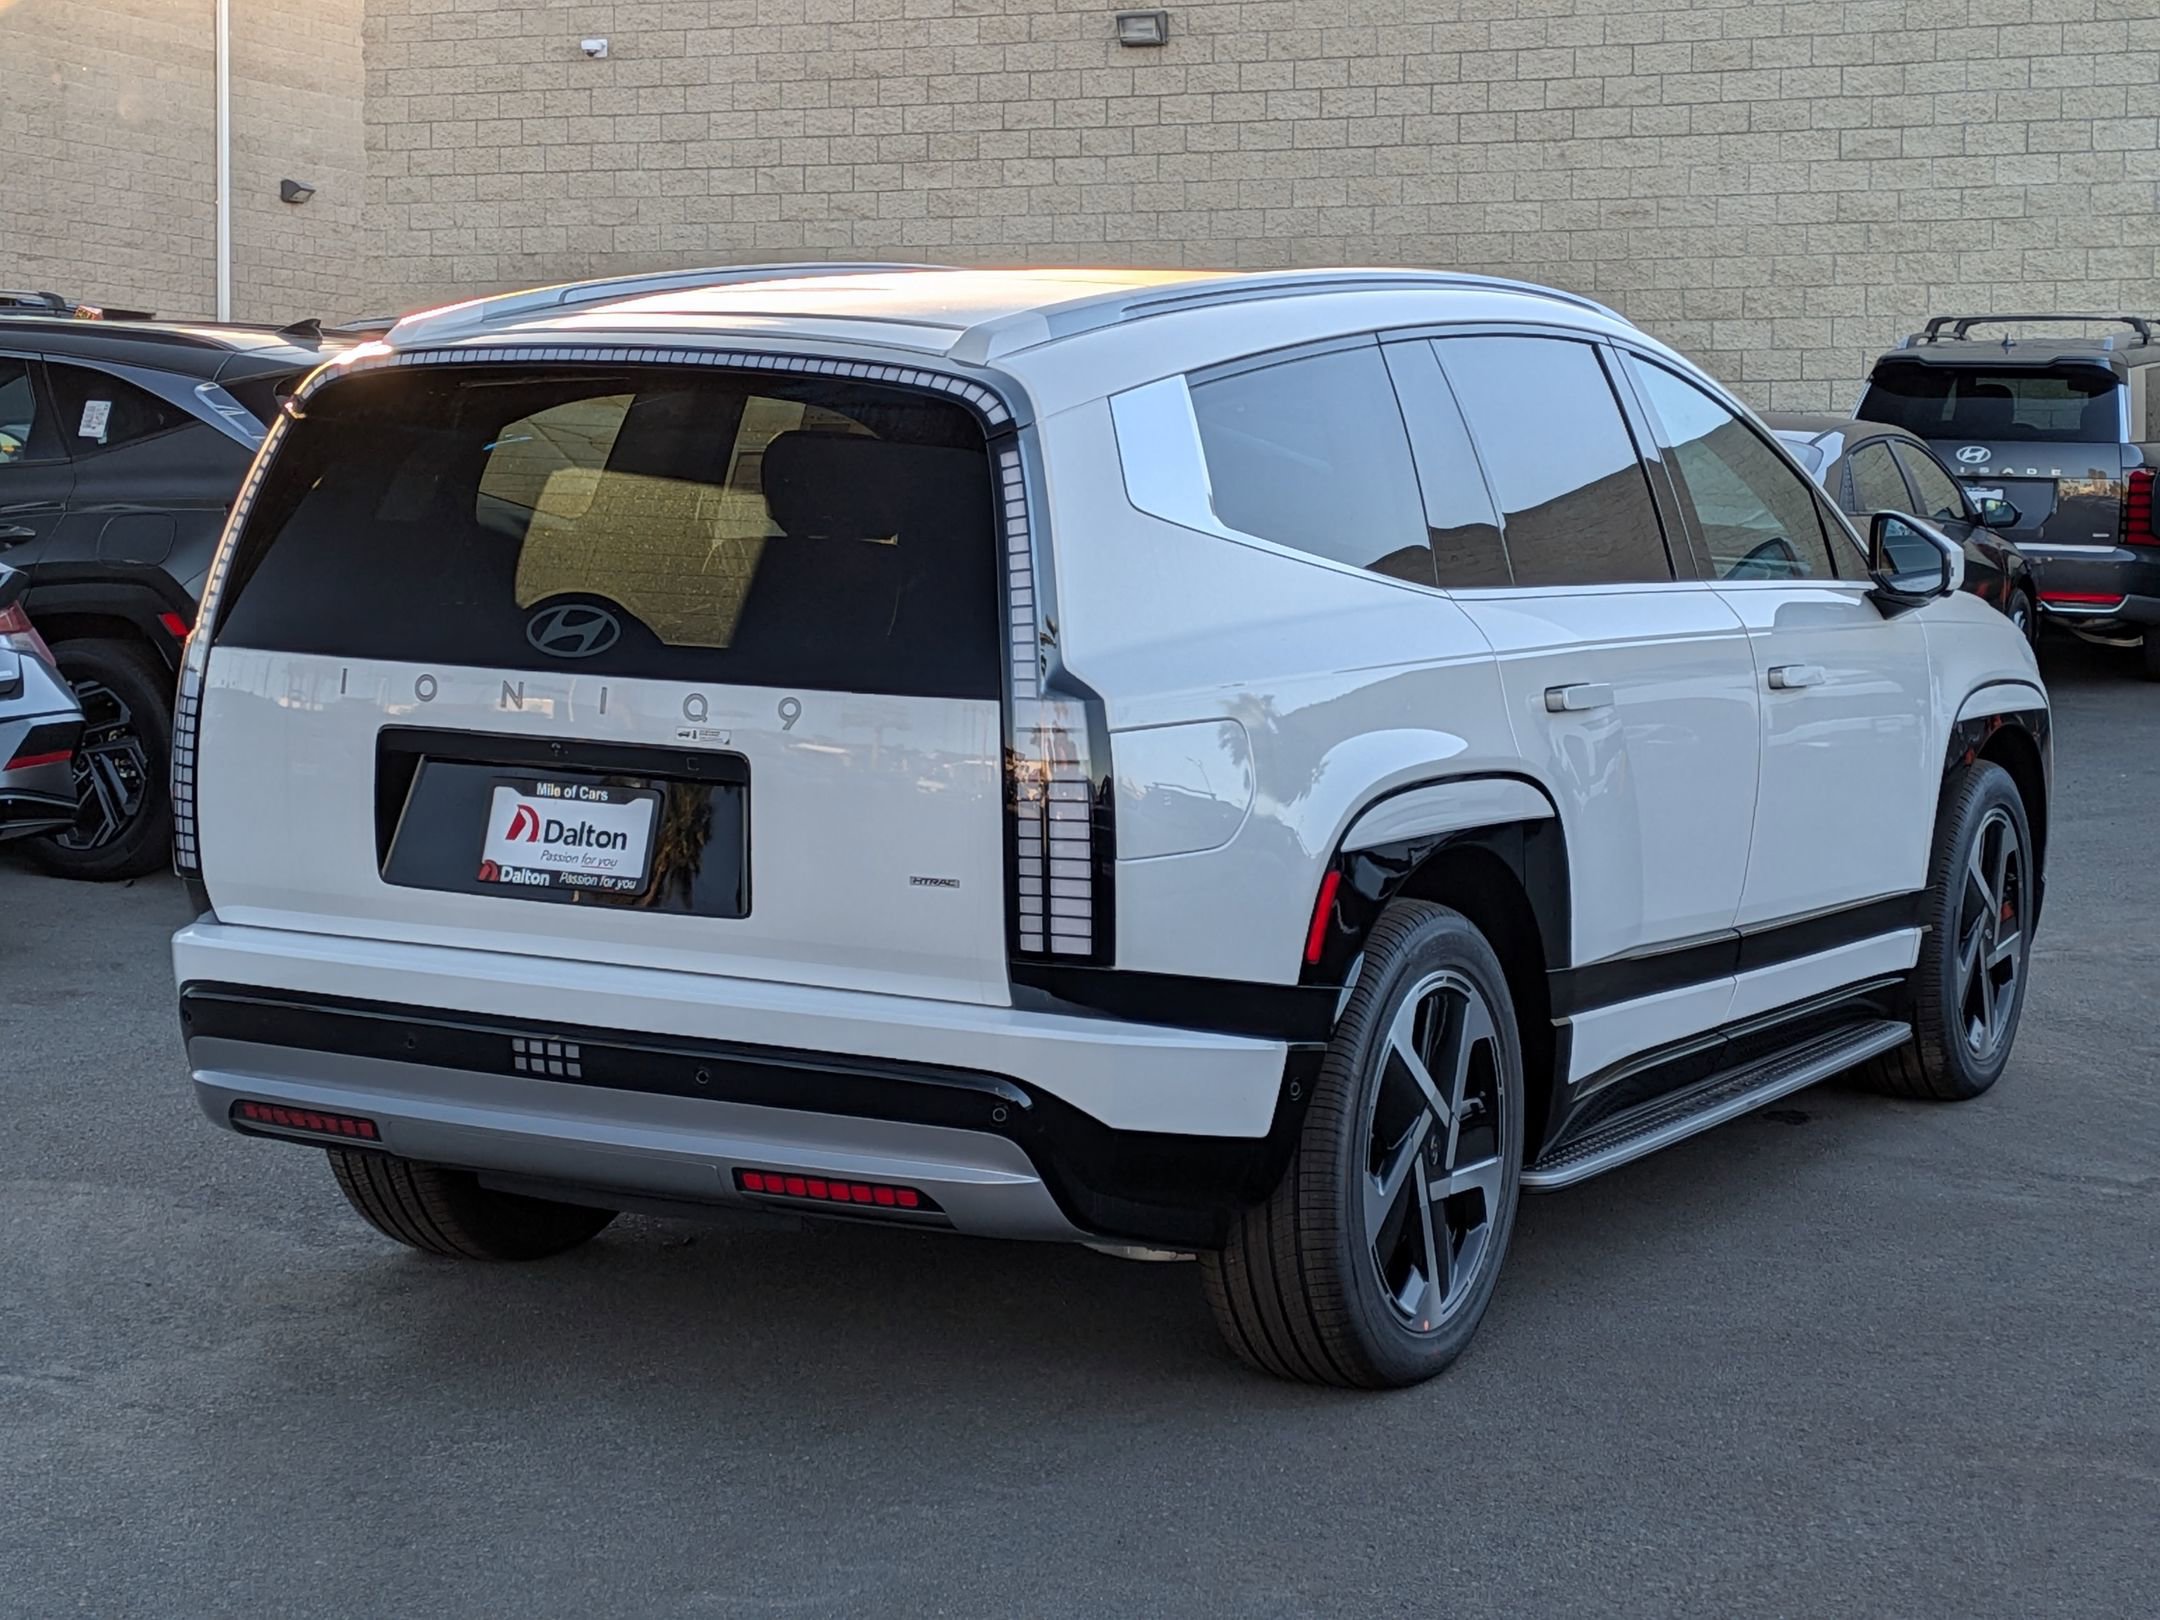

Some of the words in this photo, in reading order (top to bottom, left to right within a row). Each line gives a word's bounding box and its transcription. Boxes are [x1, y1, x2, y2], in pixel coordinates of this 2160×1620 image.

[340, 667, 708, 722] IONIQ
[778, 697, 802, 731] 9
[536, 783, 561, 797] Mile
[564, 785, 577, 798] of
[579, 787, 609, 801] Cars
[543, 819, 628, 850] Dalton
[540, 850, 579, 864] Passion
[581, 853, 596, 866] for
[598, 856, 618, 868] you
[500, 866, 550, 886] Dalton
[559, 872, 598, 886] Passion
[599, 876, 615, 889] for
[615, 877, 637, 890] you
